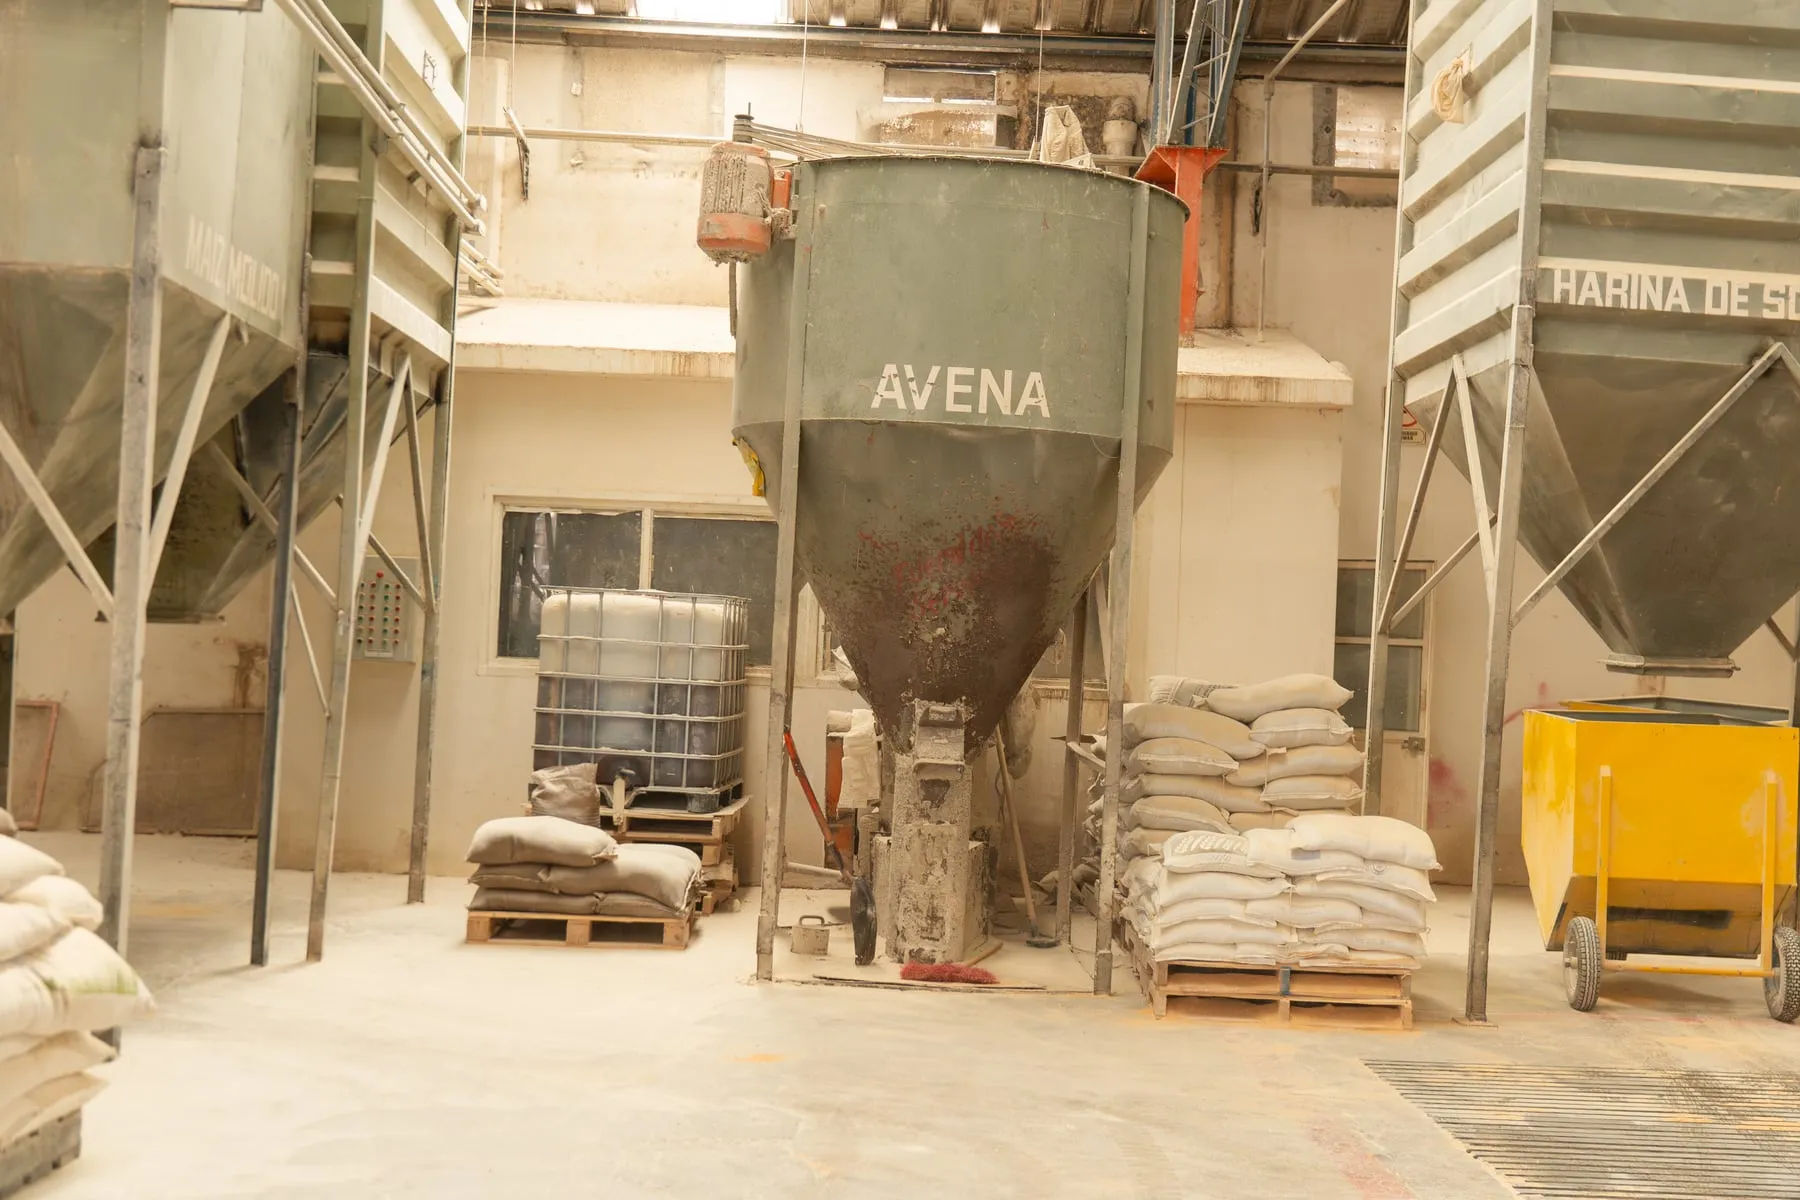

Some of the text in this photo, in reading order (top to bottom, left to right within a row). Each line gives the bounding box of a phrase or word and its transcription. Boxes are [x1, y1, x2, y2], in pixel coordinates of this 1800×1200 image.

[184, 213, 280, 321] MAIZ MOLIDO
[1553, 268, 1691, 314] HARINA
[1704, 278, 1750, 318] DE
[870, 363, 1050, 418] AVENA
